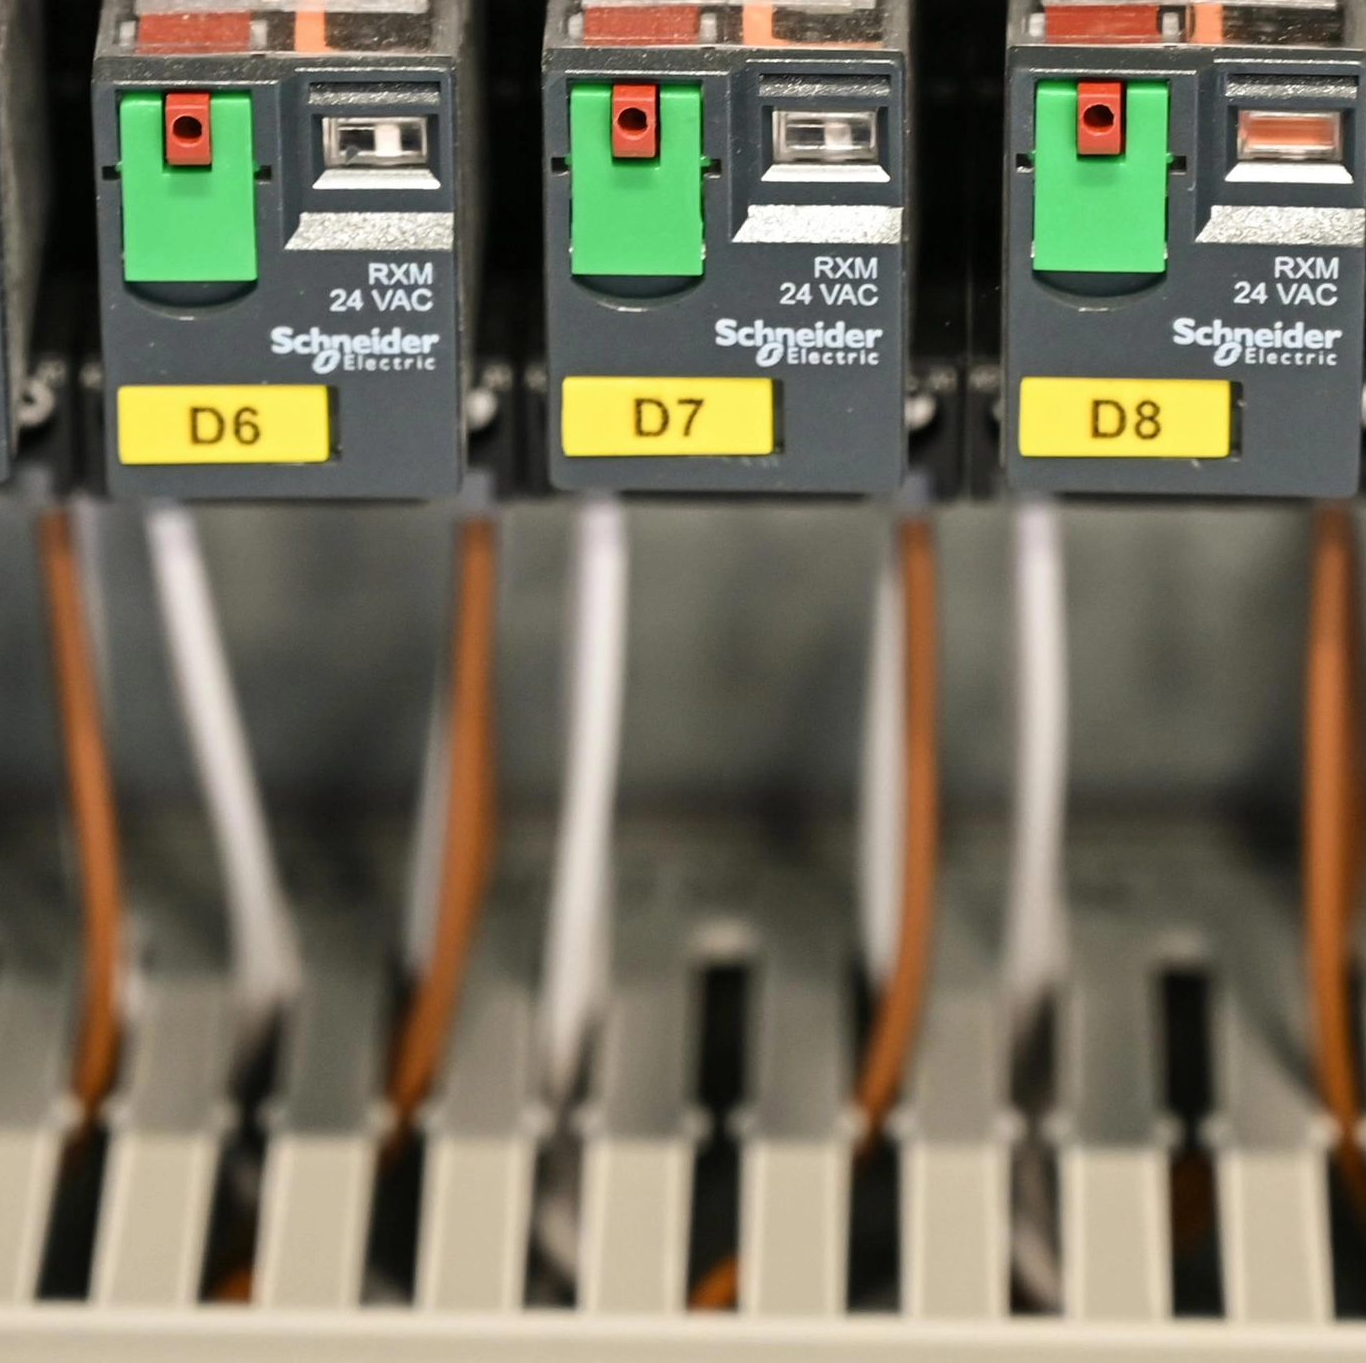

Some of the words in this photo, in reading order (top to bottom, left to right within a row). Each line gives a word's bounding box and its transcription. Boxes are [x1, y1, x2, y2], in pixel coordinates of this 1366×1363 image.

[368, 262, 433, 286] RXM
[814, 255, 878, 280] RXM
[1274, 256, 1340, 280] RXM
[329, 288, 364, 312] 24
[371, 287, 434, 312] VAC
[779, 281, 813, 305] 24
[818, 283, 879, 307] VAC
[1233, 280, 1268, 305] 24
[1275, 282, 1338, 307] VAC
[271, 327, 440, 354] Schneider
[715, 319, 883, 348] Schneider
[1173, 318, 1342, 348] Schneider
[343, 355, 436, 370] Electric
[787, 348, 879, 364] Electric
[1245, 348, 1338, 365] Electric
[189, 406, 261, 446] D6
[633, 397, 705, 438] D7
[1090, 399, 1162, 441] D8
